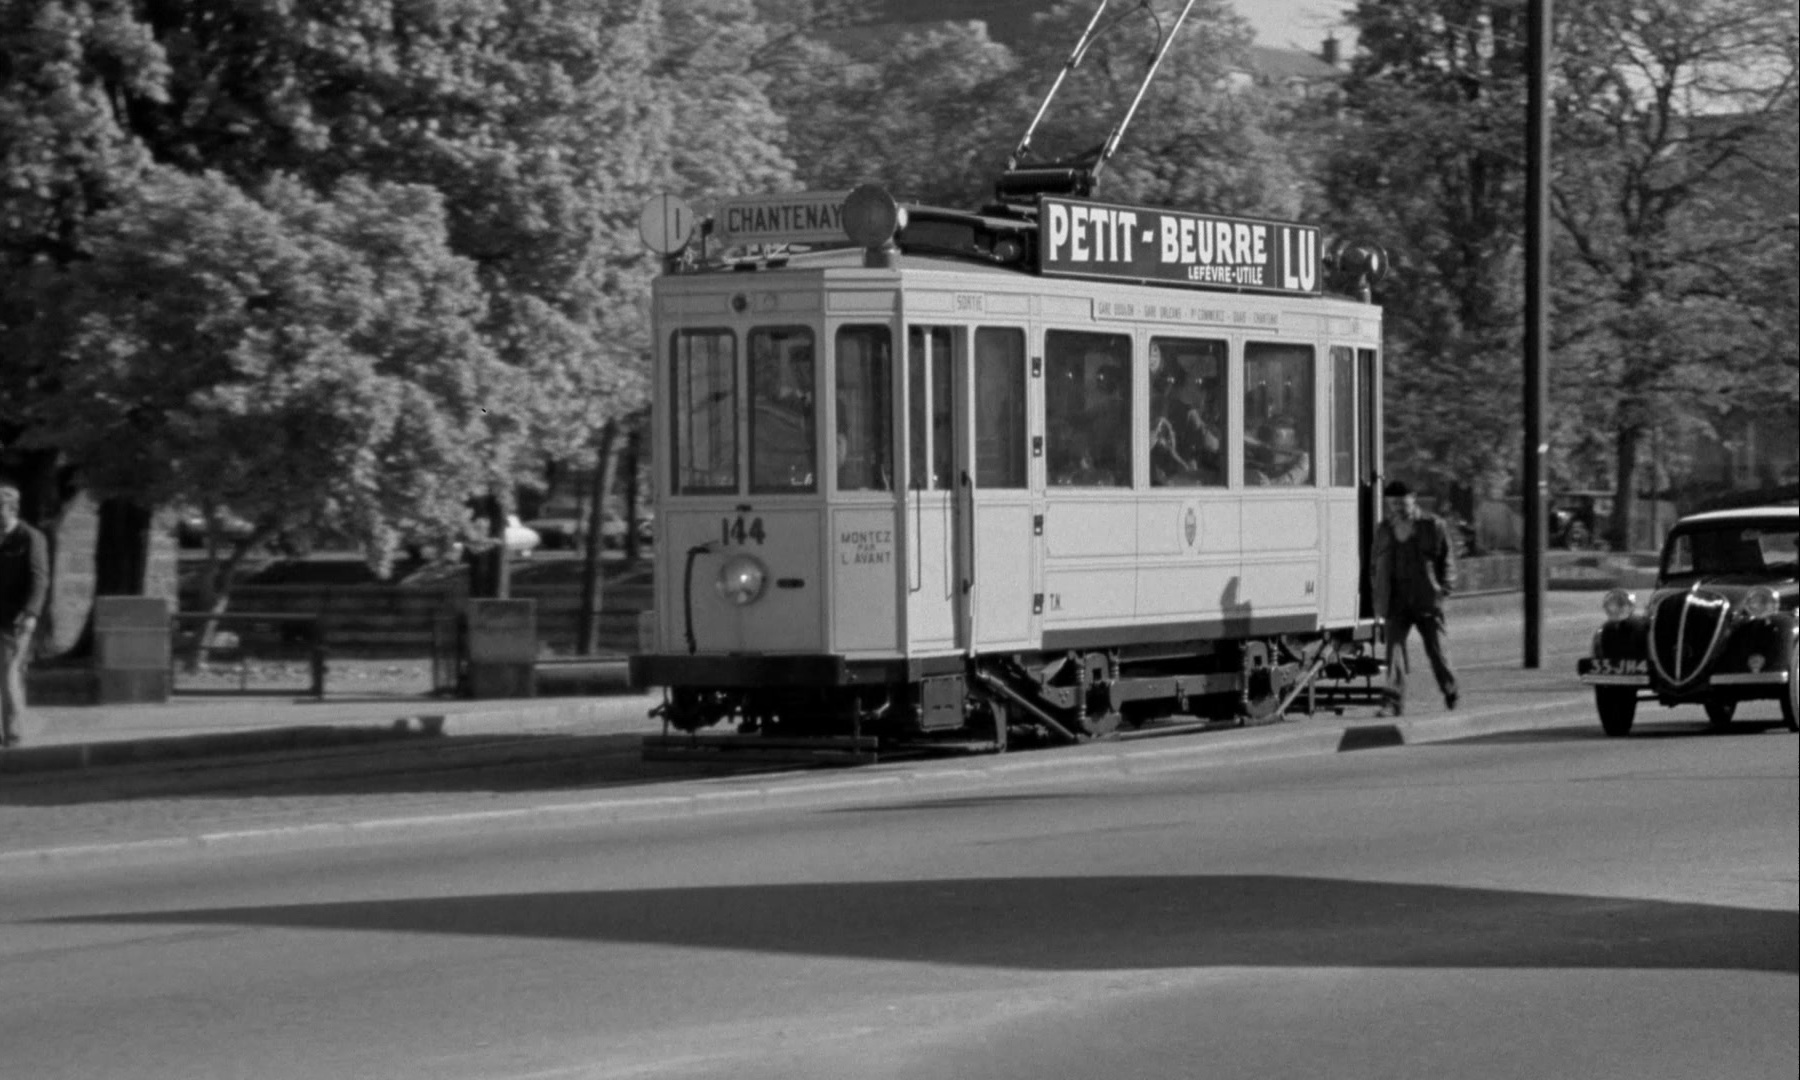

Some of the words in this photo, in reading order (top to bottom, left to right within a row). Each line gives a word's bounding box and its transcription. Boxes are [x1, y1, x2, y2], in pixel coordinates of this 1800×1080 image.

[729, 204, 843, 232] CHANTENAY
[1048, 203, 1137, 262] PETIT
[1160, 216, 1267, 265] BEURRE
[1283, 228, 1315, 291] LU
[722, 517, 766, 546] 144
[841, 531, 892, 544] MONTEZ
[854, 551, 892, 564] AVANT
